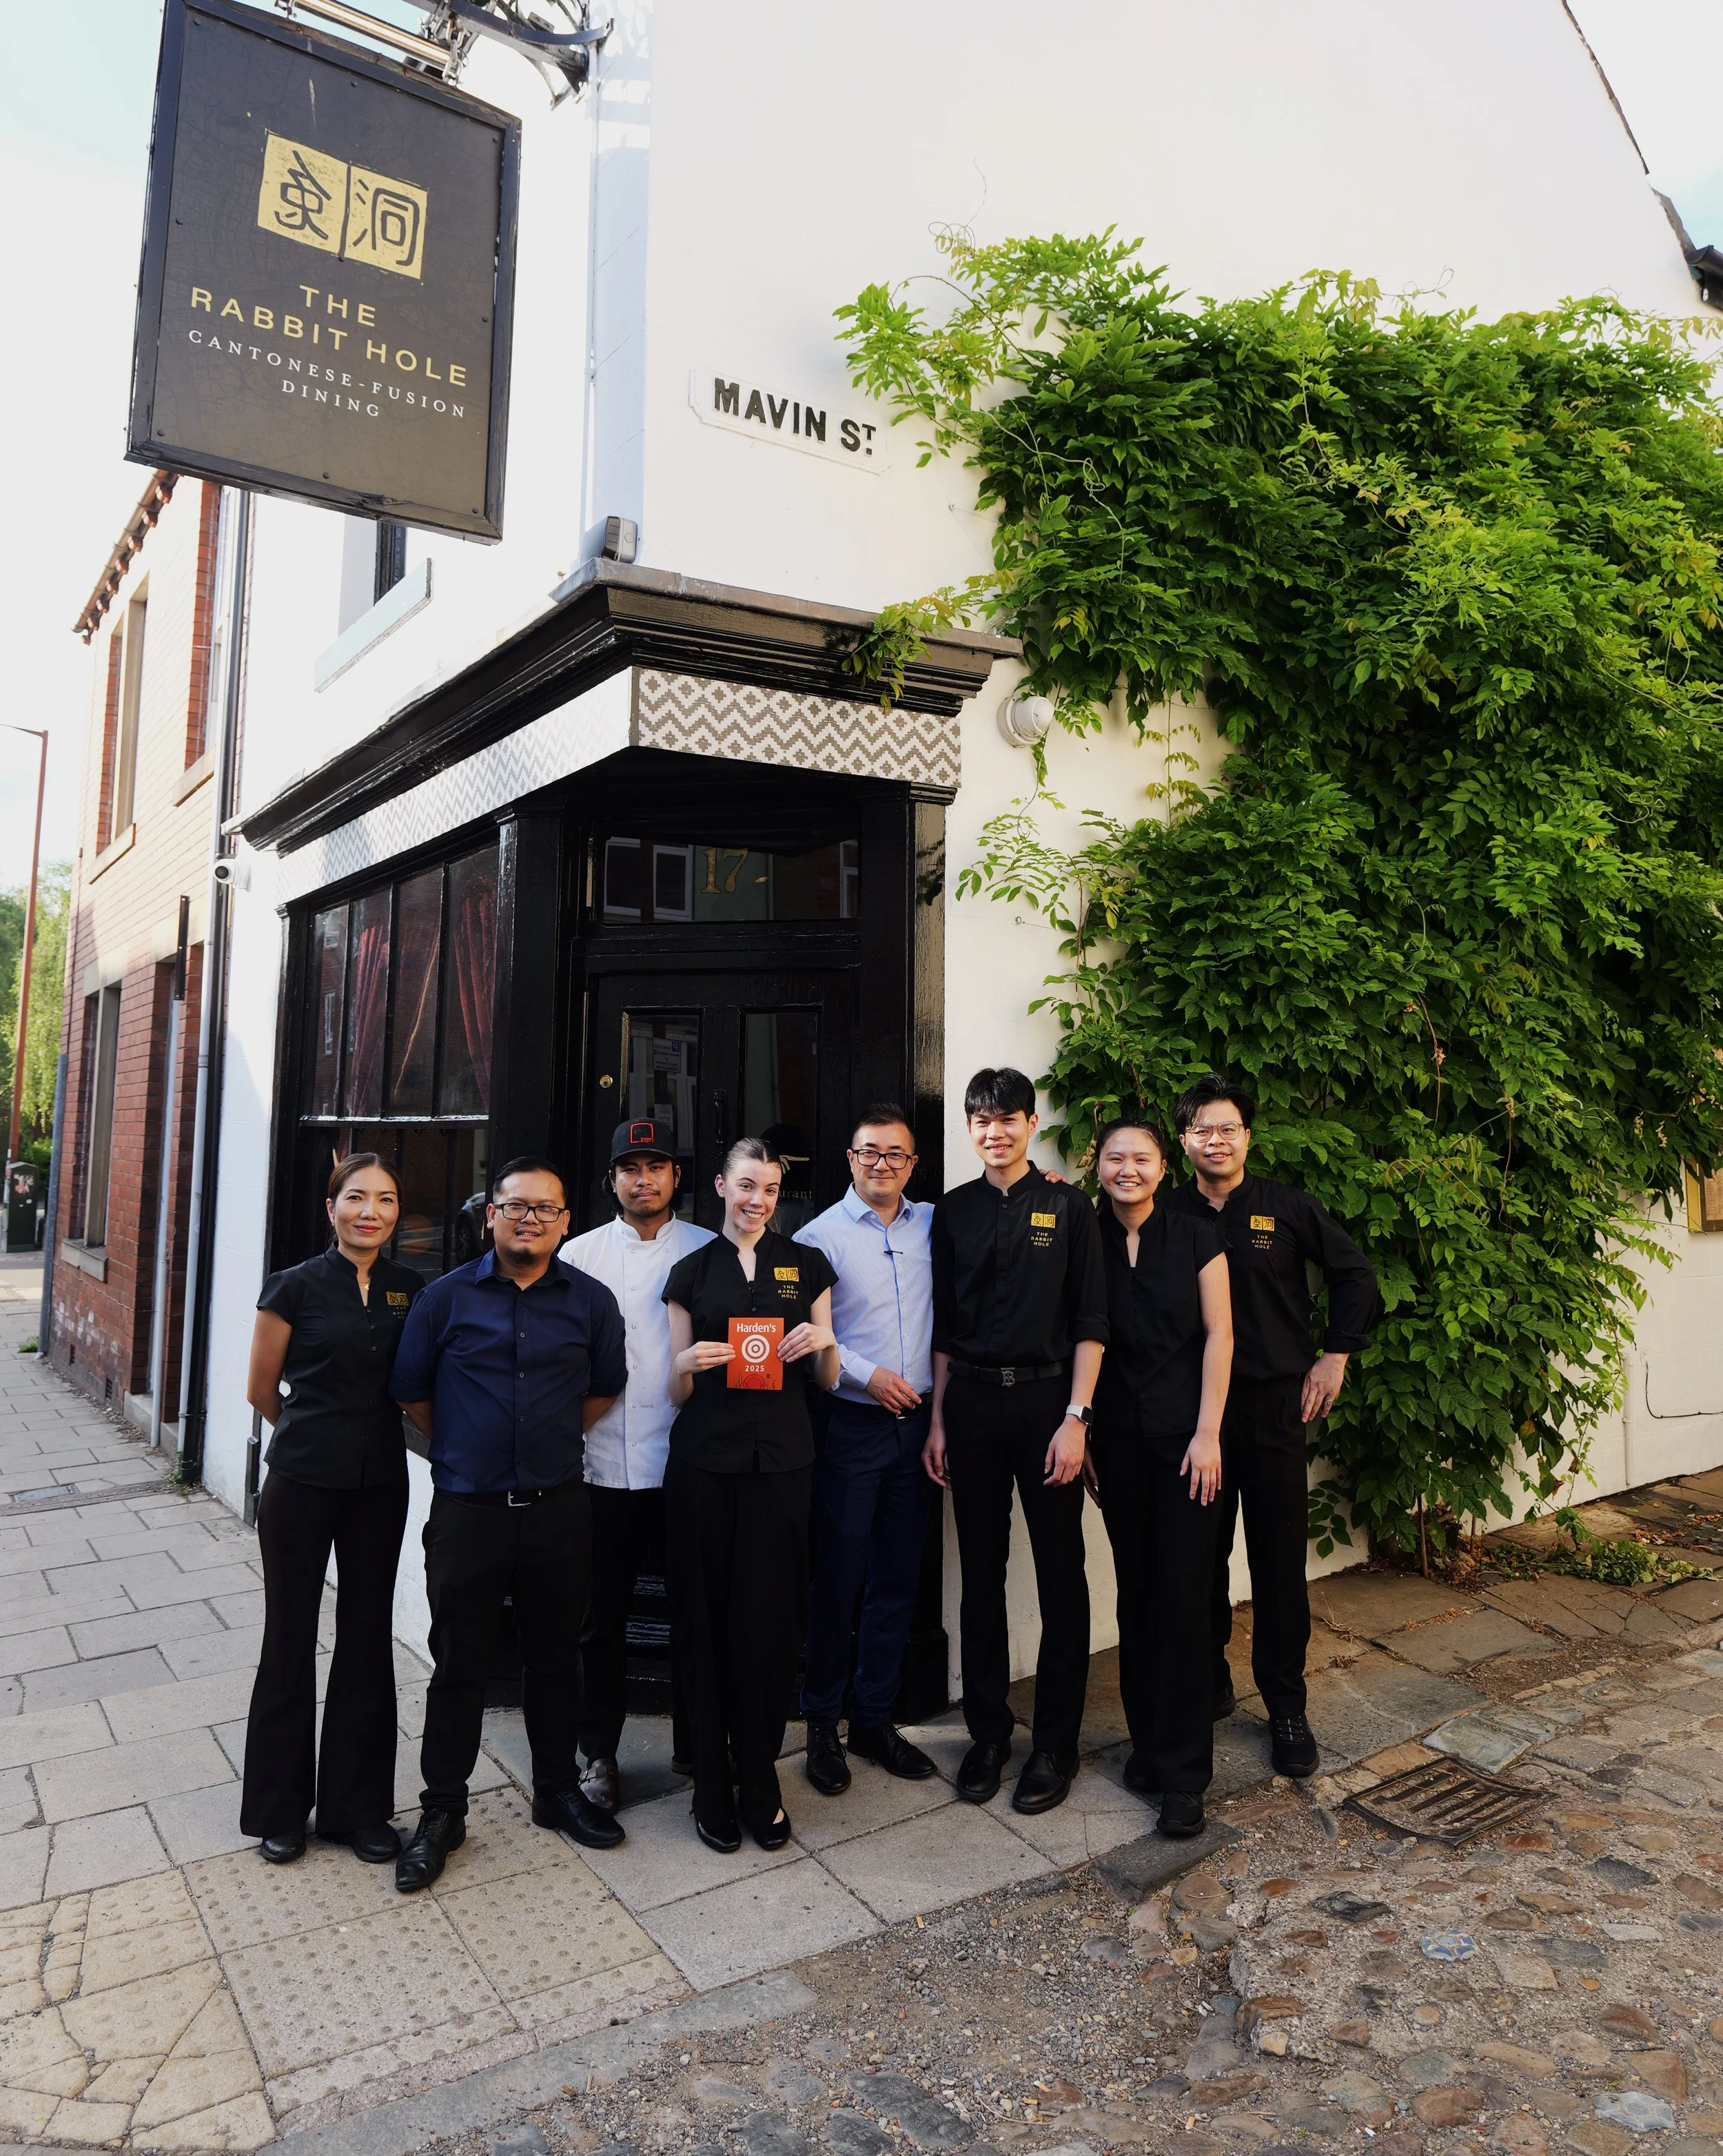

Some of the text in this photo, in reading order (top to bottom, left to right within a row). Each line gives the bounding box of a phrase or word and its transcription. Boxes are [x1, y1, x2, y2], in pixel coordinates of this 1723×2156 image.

[299, 284, 376, 327] THE
[192, 286, 467, 387] RABBIT HOLE
[188, 329, 466, 419] CANTONESE-FUSION
[281, 379, 380, 418] DINING
[714, 378, 826, 442] MAVIN
[700, 847, 749, 894] 17
[737, 1322, 776, 1333] Harden's
